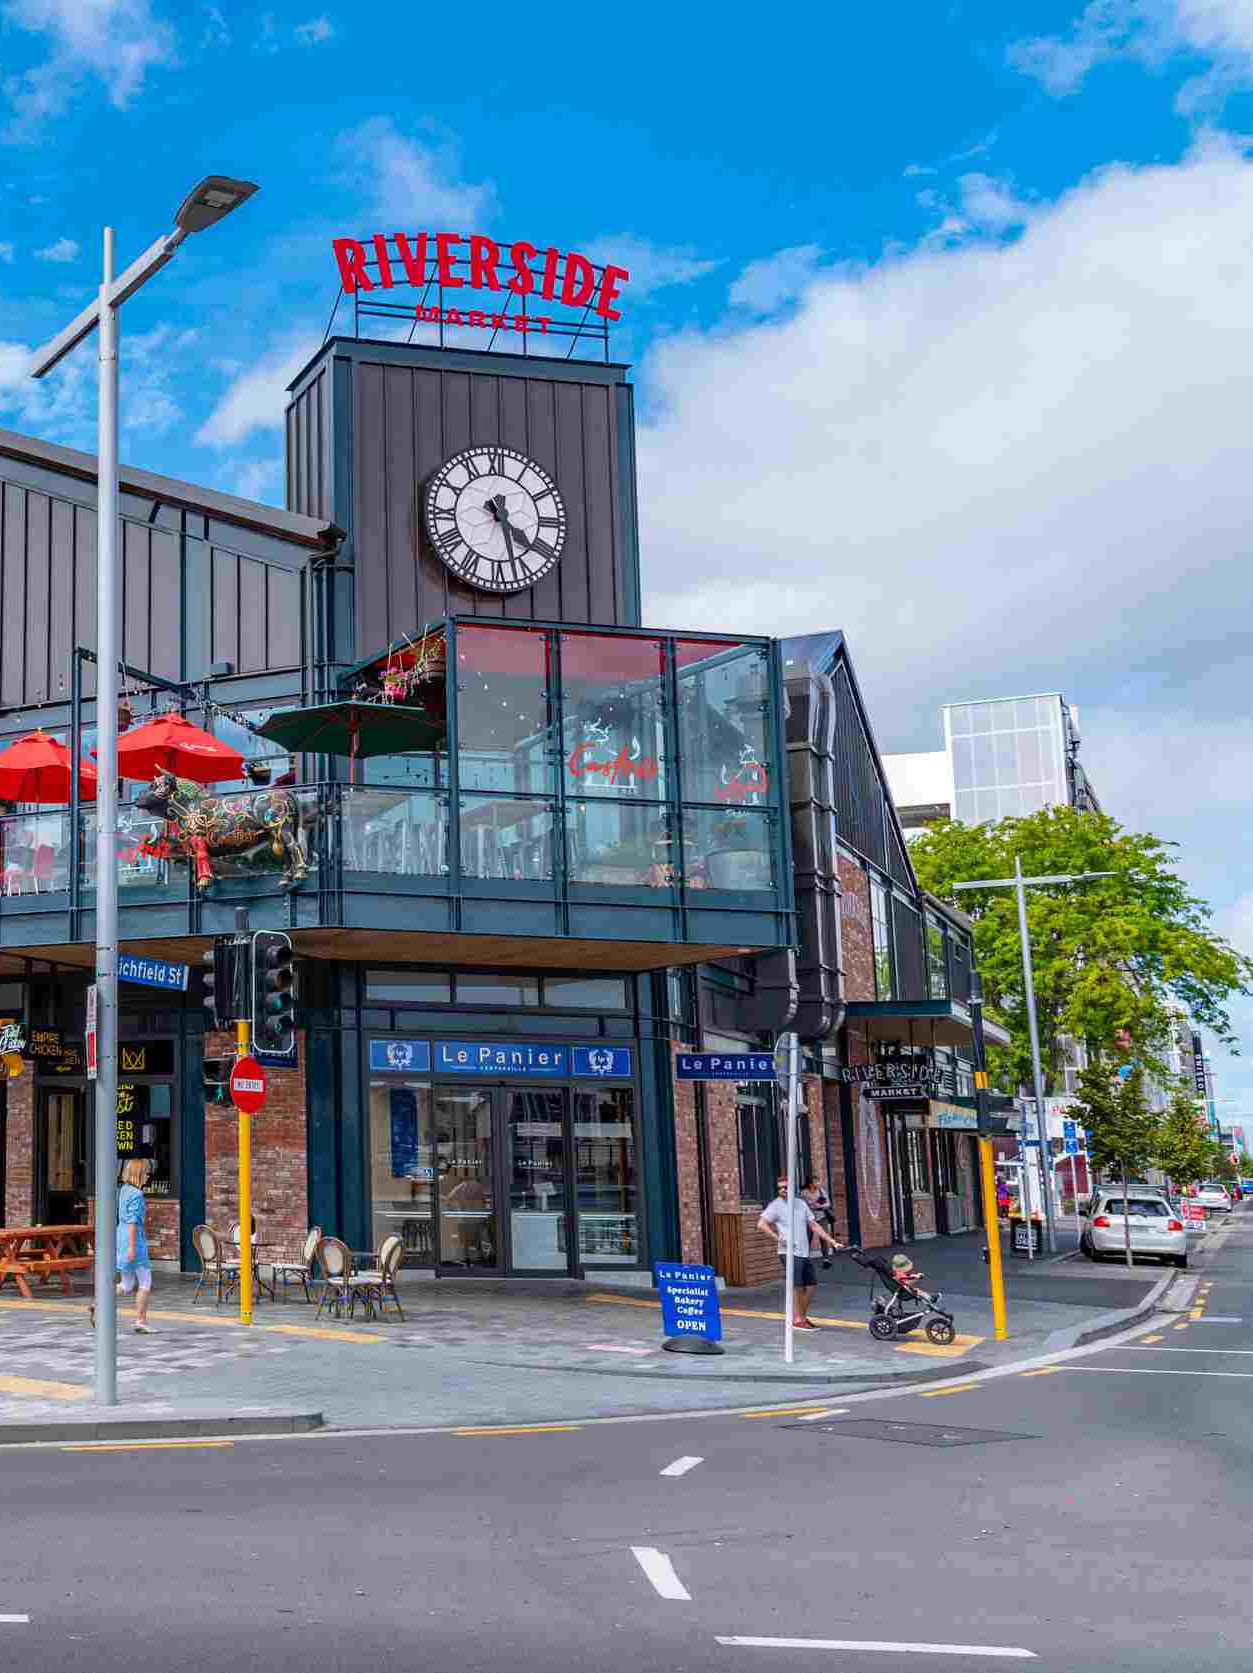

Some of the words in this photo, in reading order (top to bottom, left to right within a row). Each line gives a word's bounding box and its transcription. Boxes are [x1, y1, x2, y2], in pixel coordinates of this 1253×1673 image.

[332, 232, 629, 321] RIVERSIDE
[414, 304, 554, 335] MARKET
[119, 957, 168, 983] ichfield
[169, 967, 182, 984] St
[442, 1046, 467, 1063] Le
[479, 1047, 562, 1066] Panier
[682, 1058, 703, 1071] Le
[841, 1062, 945, 1085] RIVERSIDE
[870, 1088, 918, 1098] MARKET
[659, 1270, 671, 1279] Le
[675, 1271, 712, 1281] Panier
[666, 1285, 709, 1297] Specialist
[674, 1296, 705, 1307] Bakery
[676, 1306, 704, 1316] Coffee
[676, 1319, 707, 1331] OPEN
